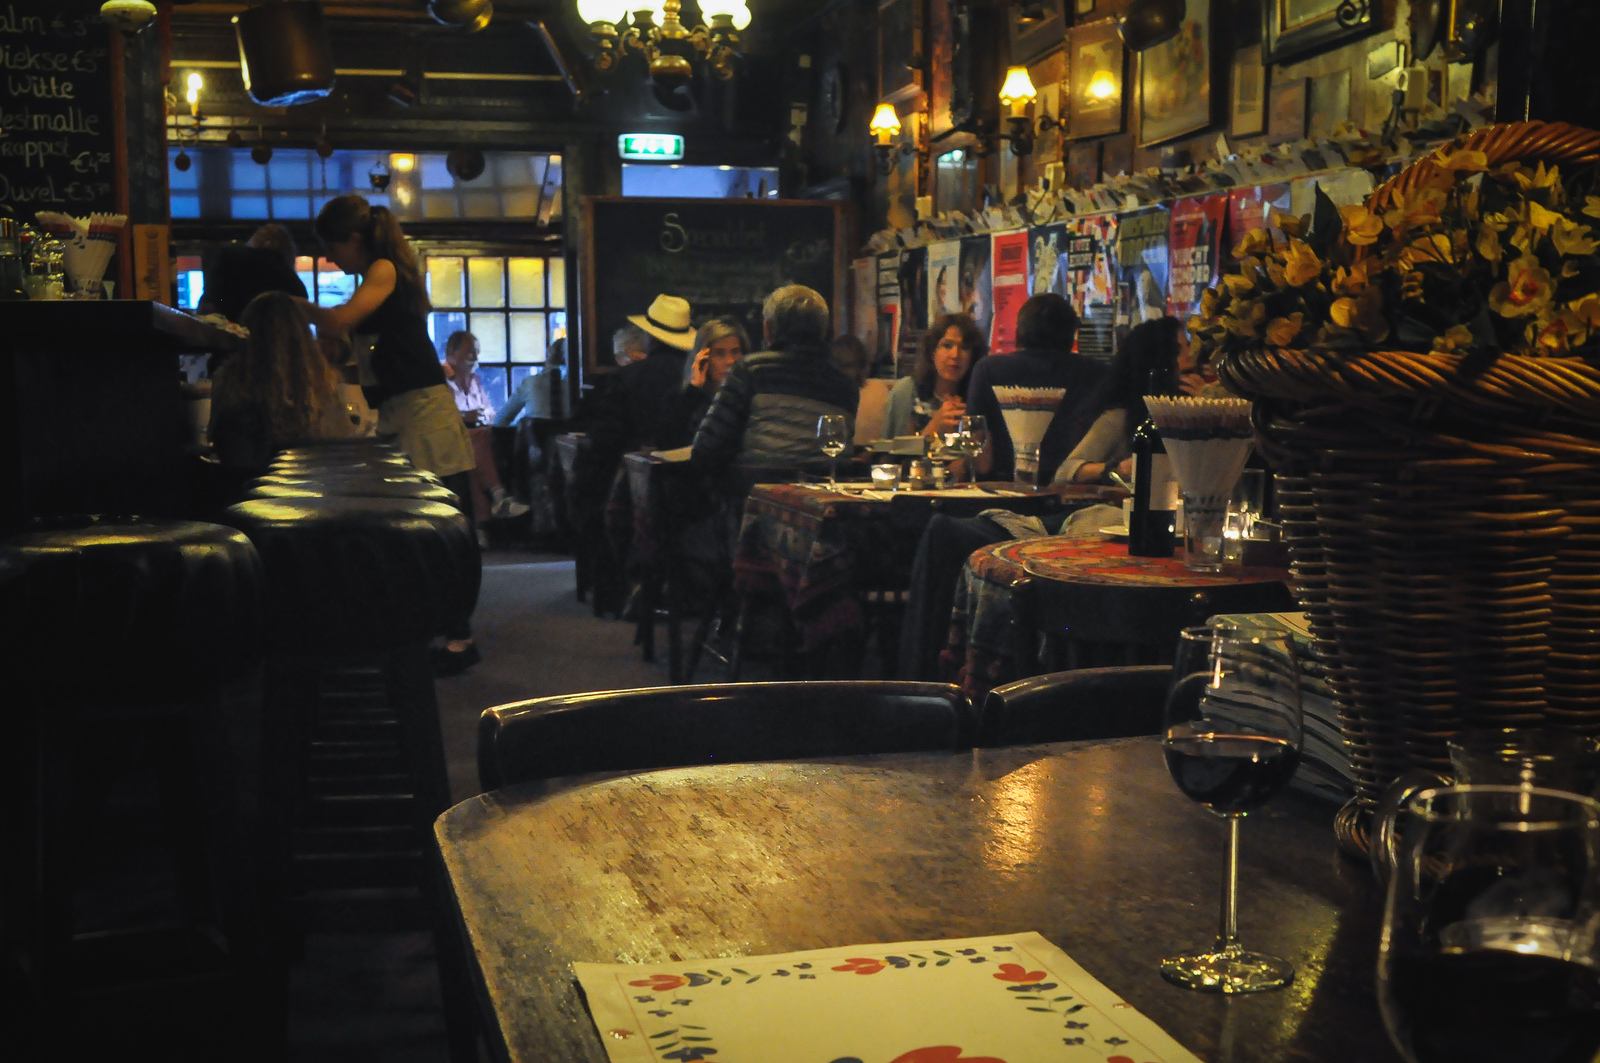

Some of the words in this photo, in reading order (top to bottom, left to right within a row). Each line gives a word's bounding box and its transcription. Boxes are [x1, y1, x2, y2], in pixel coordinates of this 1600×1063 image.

[0, 43, 68, 71] iekse
[8, 69, 75, 99] Witte
[0, 104, 100, 135] estmalle
